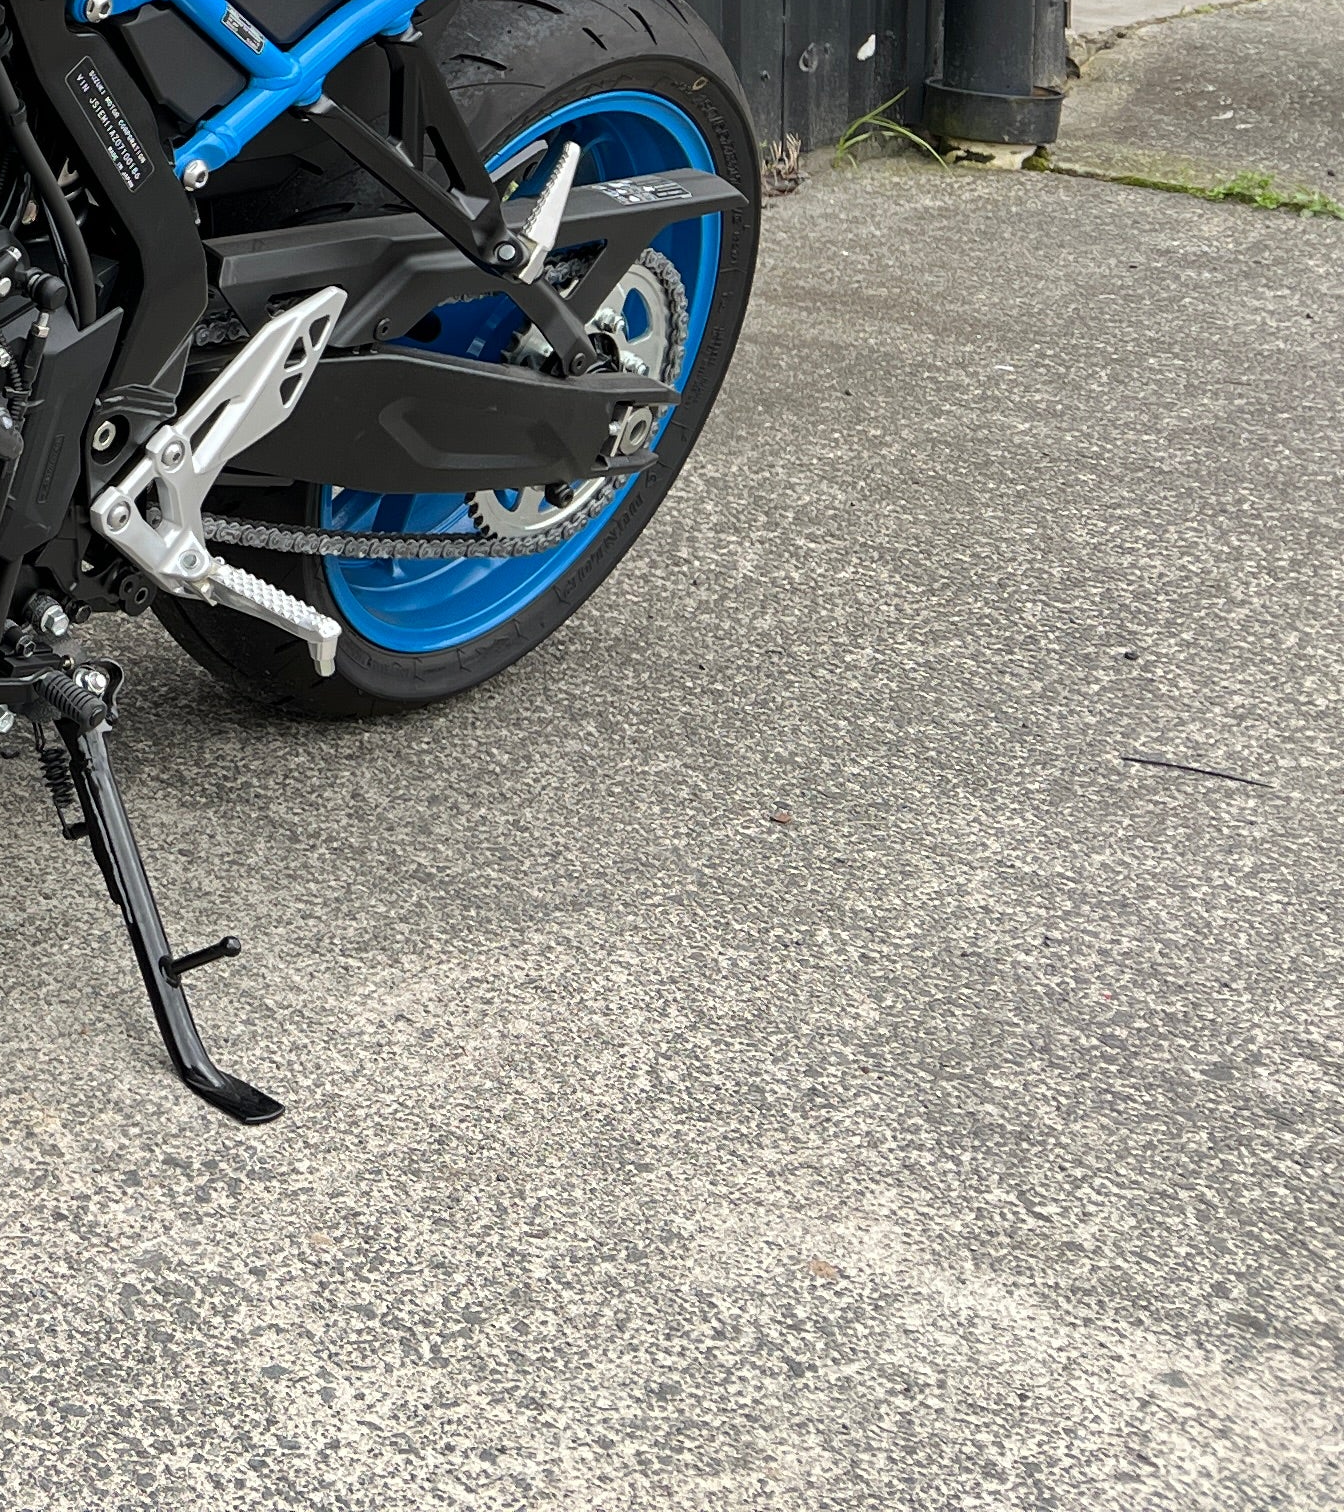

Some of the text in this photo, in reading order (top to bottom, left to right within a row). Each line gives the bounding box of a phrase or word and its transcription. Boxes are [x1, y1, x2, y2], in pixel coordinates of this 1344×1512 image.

[75, 73, 90, 93] VIN
[88, 69, 147, 164] SUZUKI MOTOR CORPORATION
